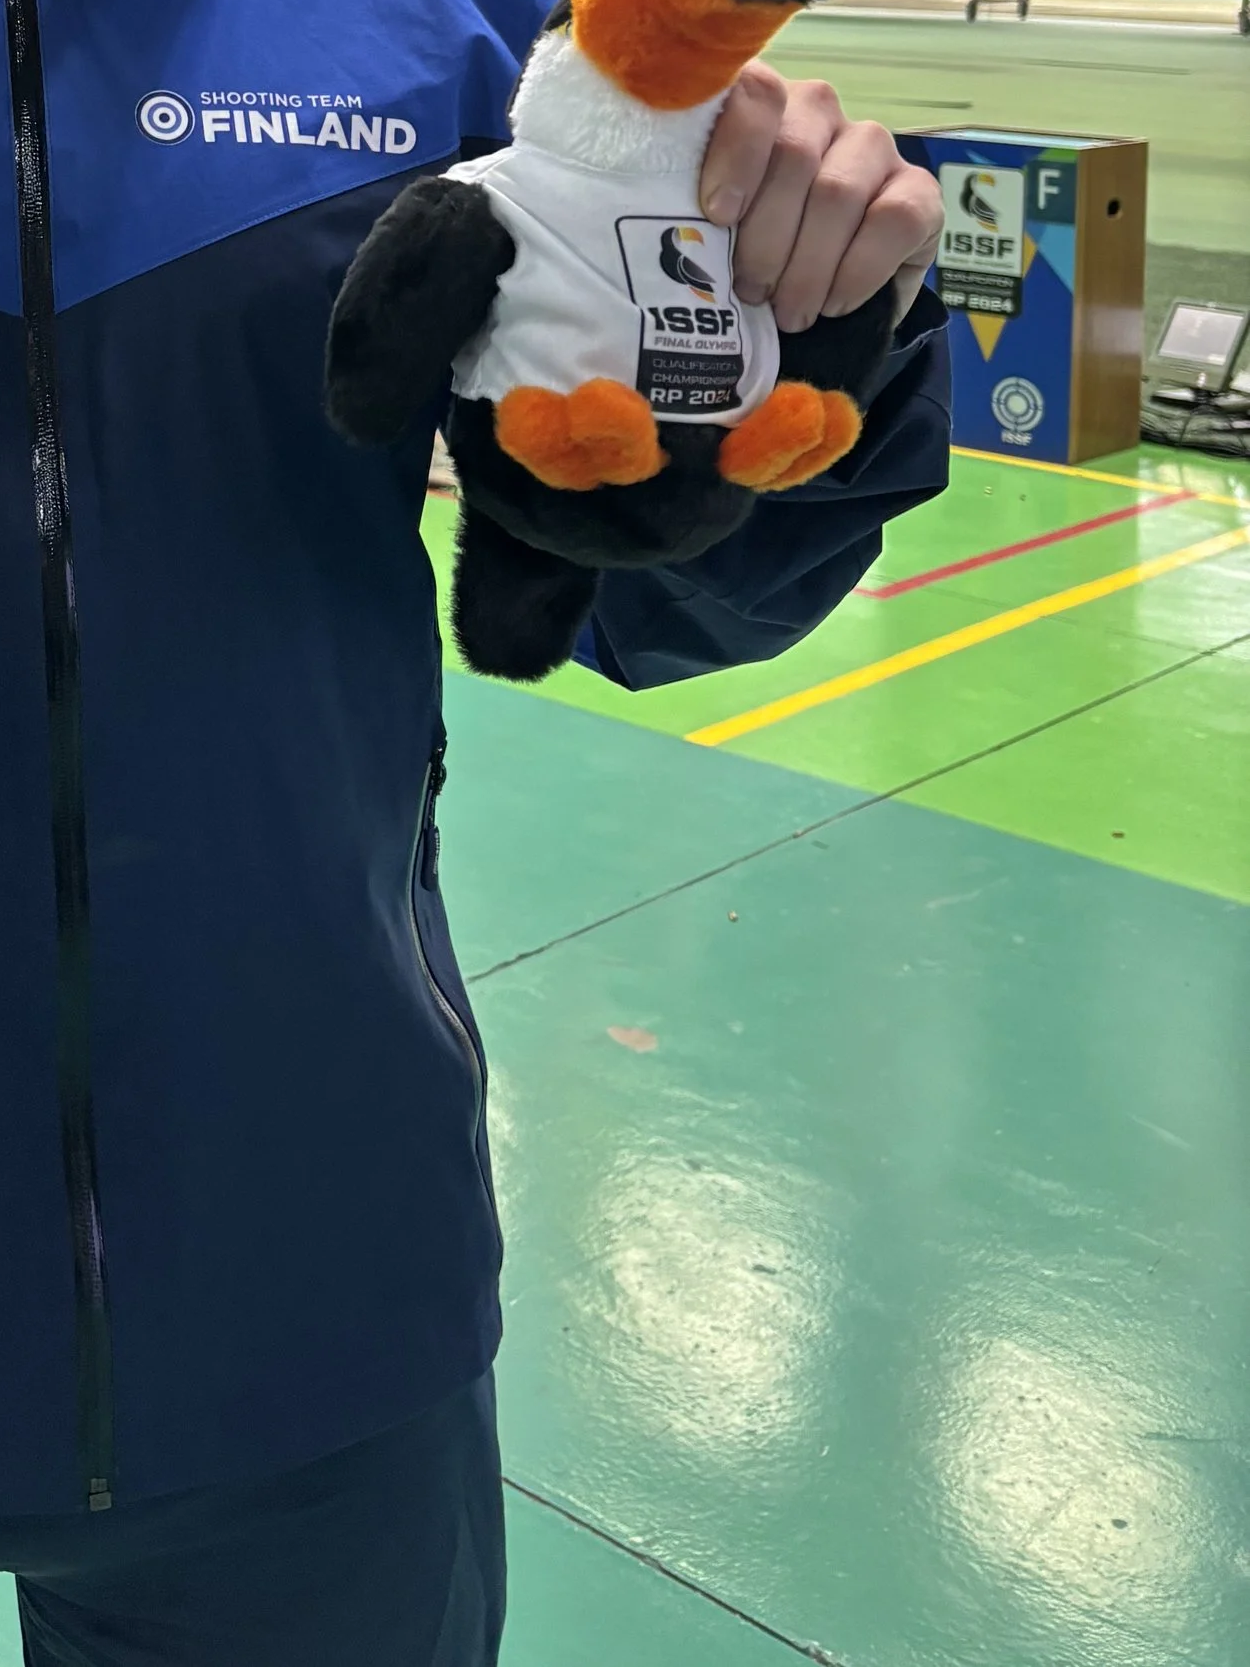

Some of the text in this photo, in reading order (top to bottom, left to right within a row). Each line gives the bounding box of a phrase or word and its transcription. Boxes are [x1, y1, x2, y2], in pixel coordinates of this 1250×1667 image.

[200, 91, 362, 109] SHOOTING TEAM
[201, 110, 417, 154] FINLAND
[1038, 168, 1061, 210] F
[945, 231, 1015, 259] ISSF
[648, 307, 735, 336] ISSF
[654, 336, 692, 349] FINAL
[650, 387, 730, 405] RP 2024
